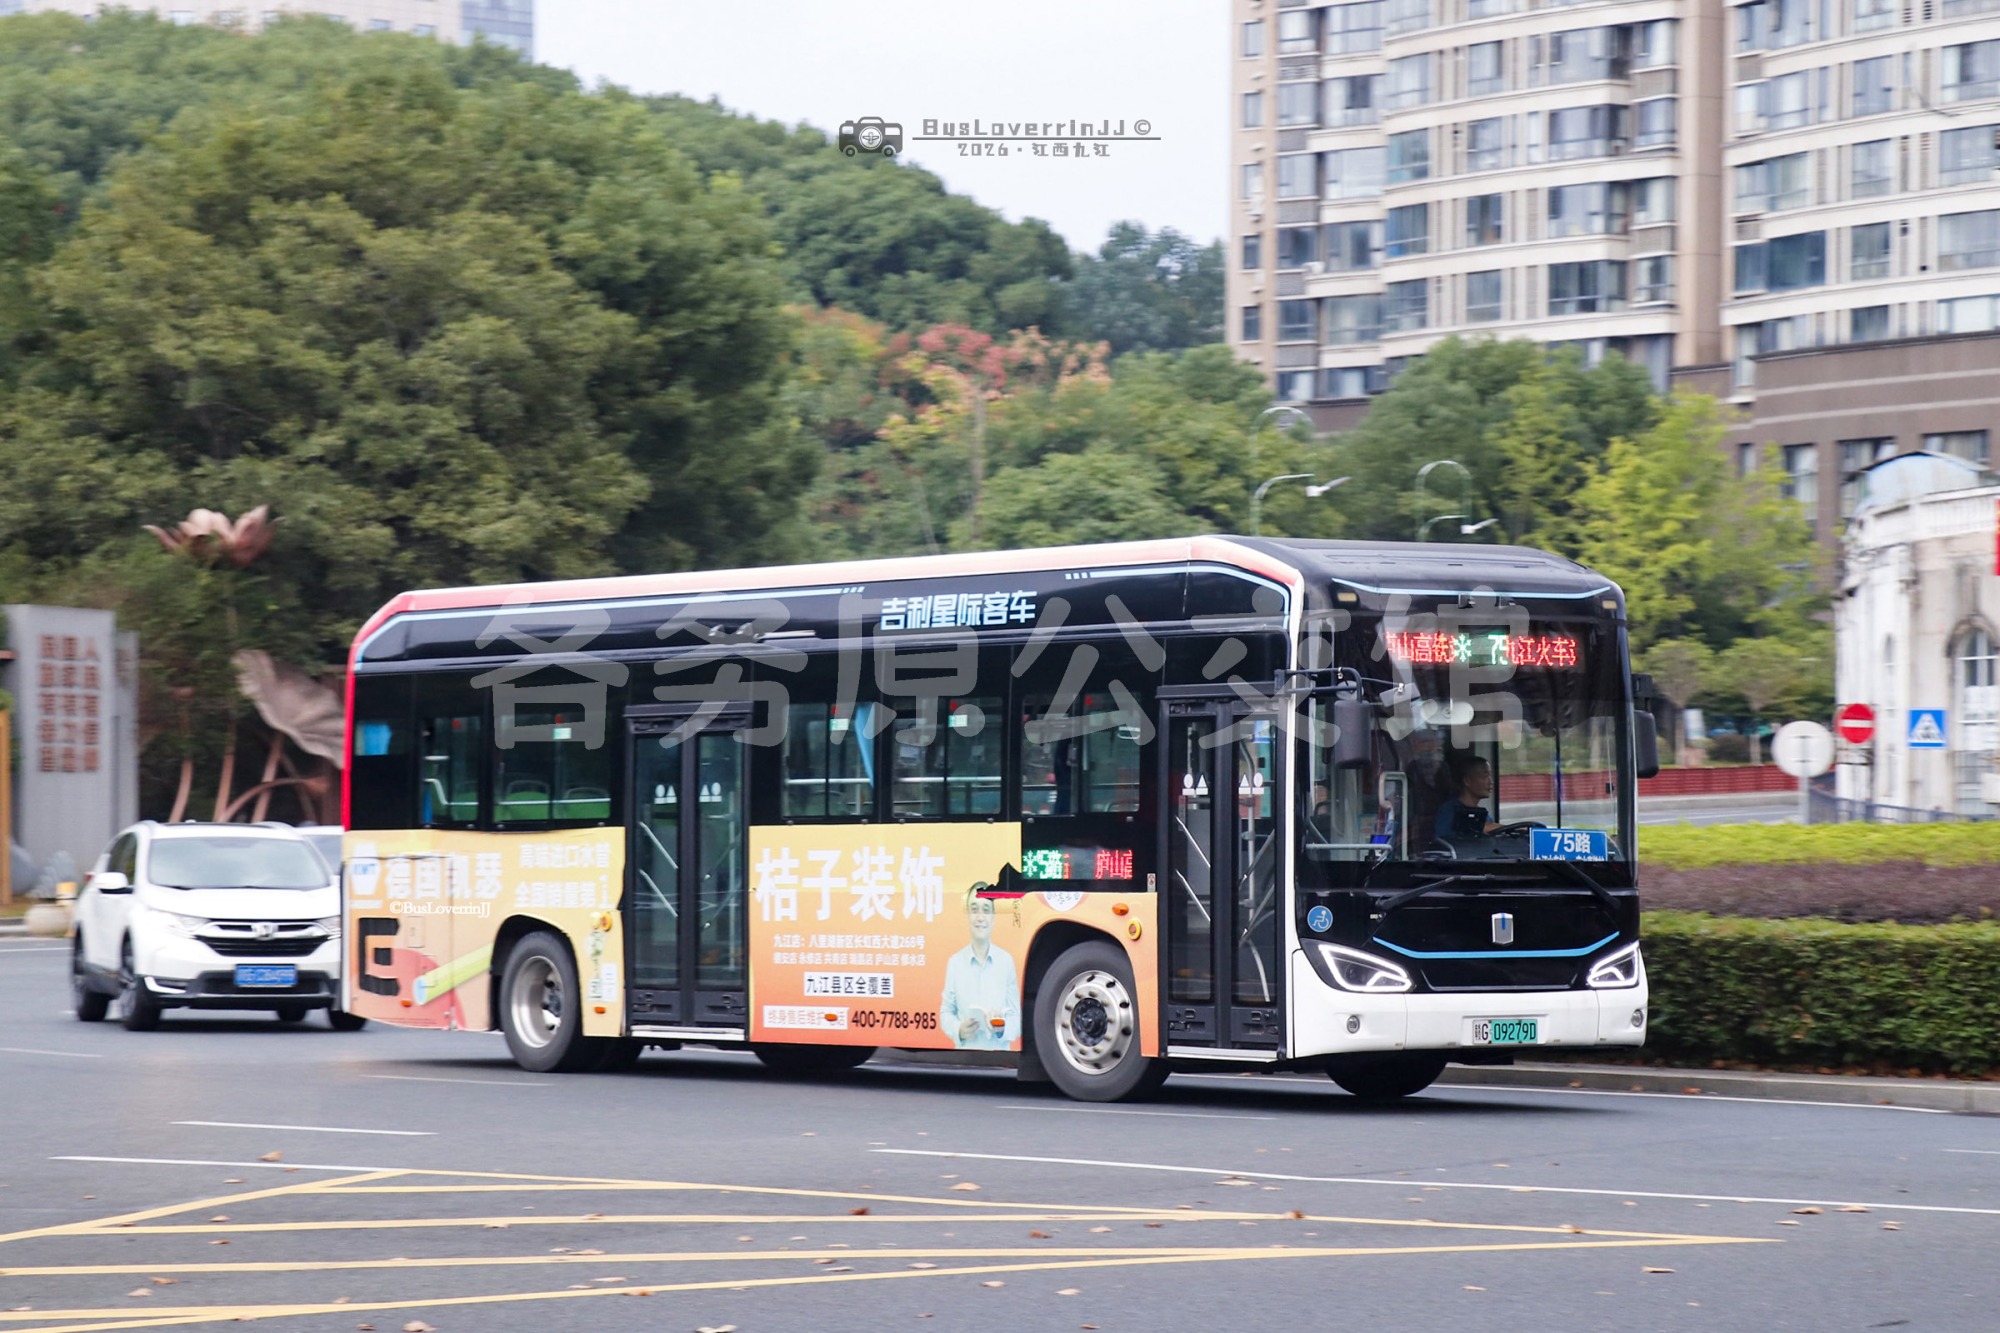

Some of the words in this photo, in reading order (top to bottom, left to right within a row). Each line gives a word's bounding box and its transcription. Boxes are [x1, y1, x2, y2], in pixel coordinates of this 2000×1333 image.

[880, 590, 1038, 630] 吉利星际客车
[1551, 832, 1591, 854] 75路
[754, 846, 945, 922] 桔子装饰
[807, 975, 892, 995] 九江县区全覆盖
[851, 1010, 937, 1030] 400-7788-985
